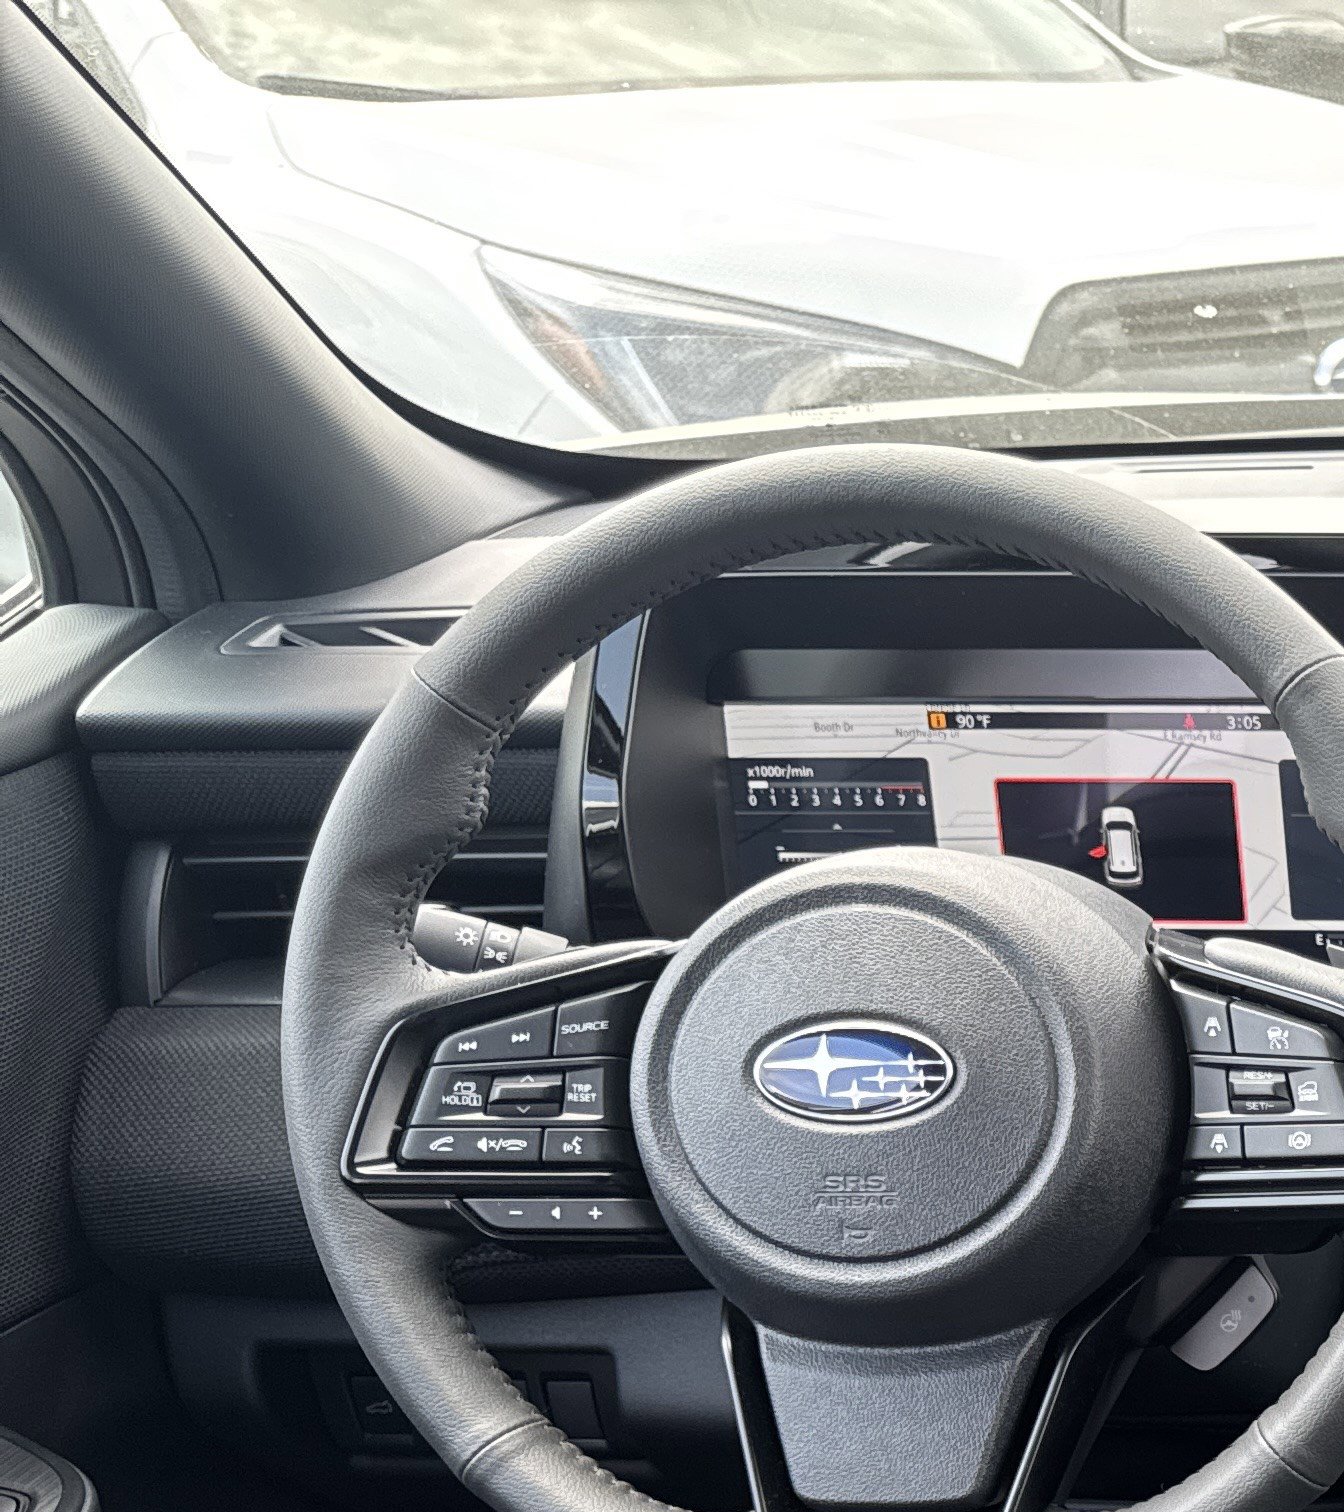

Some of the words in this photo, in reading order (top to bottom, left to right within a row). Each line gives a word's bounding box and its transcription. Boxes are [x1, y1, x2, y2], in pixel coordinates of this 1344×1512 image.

[814, 721, 837, 733] Booth
[838, 722, 854, 733] Dr
[1226, 715, 1262, 730] 3:05
[749, 794, 758, 807] 0
[770, 794, 777, 807] 1
[790, 794, 799, 807] 2
[812, 794, 821, 807] 3
[832, 794, 842, 807] 4
[854, 794, 863, 807] 5
[875, 794, 884, 807] 6
[896, 794, 906, 807] 7
[917, 794, 927, 807] 8
[1315, 933, 1325, 945] E
[561, 1020, 609, 1035] SOURCE
[572, 1083, 592, 1093] TRIP
[567, 1092, 597, 1103] RESET
[823, 1175, 888, 1193] SRS
